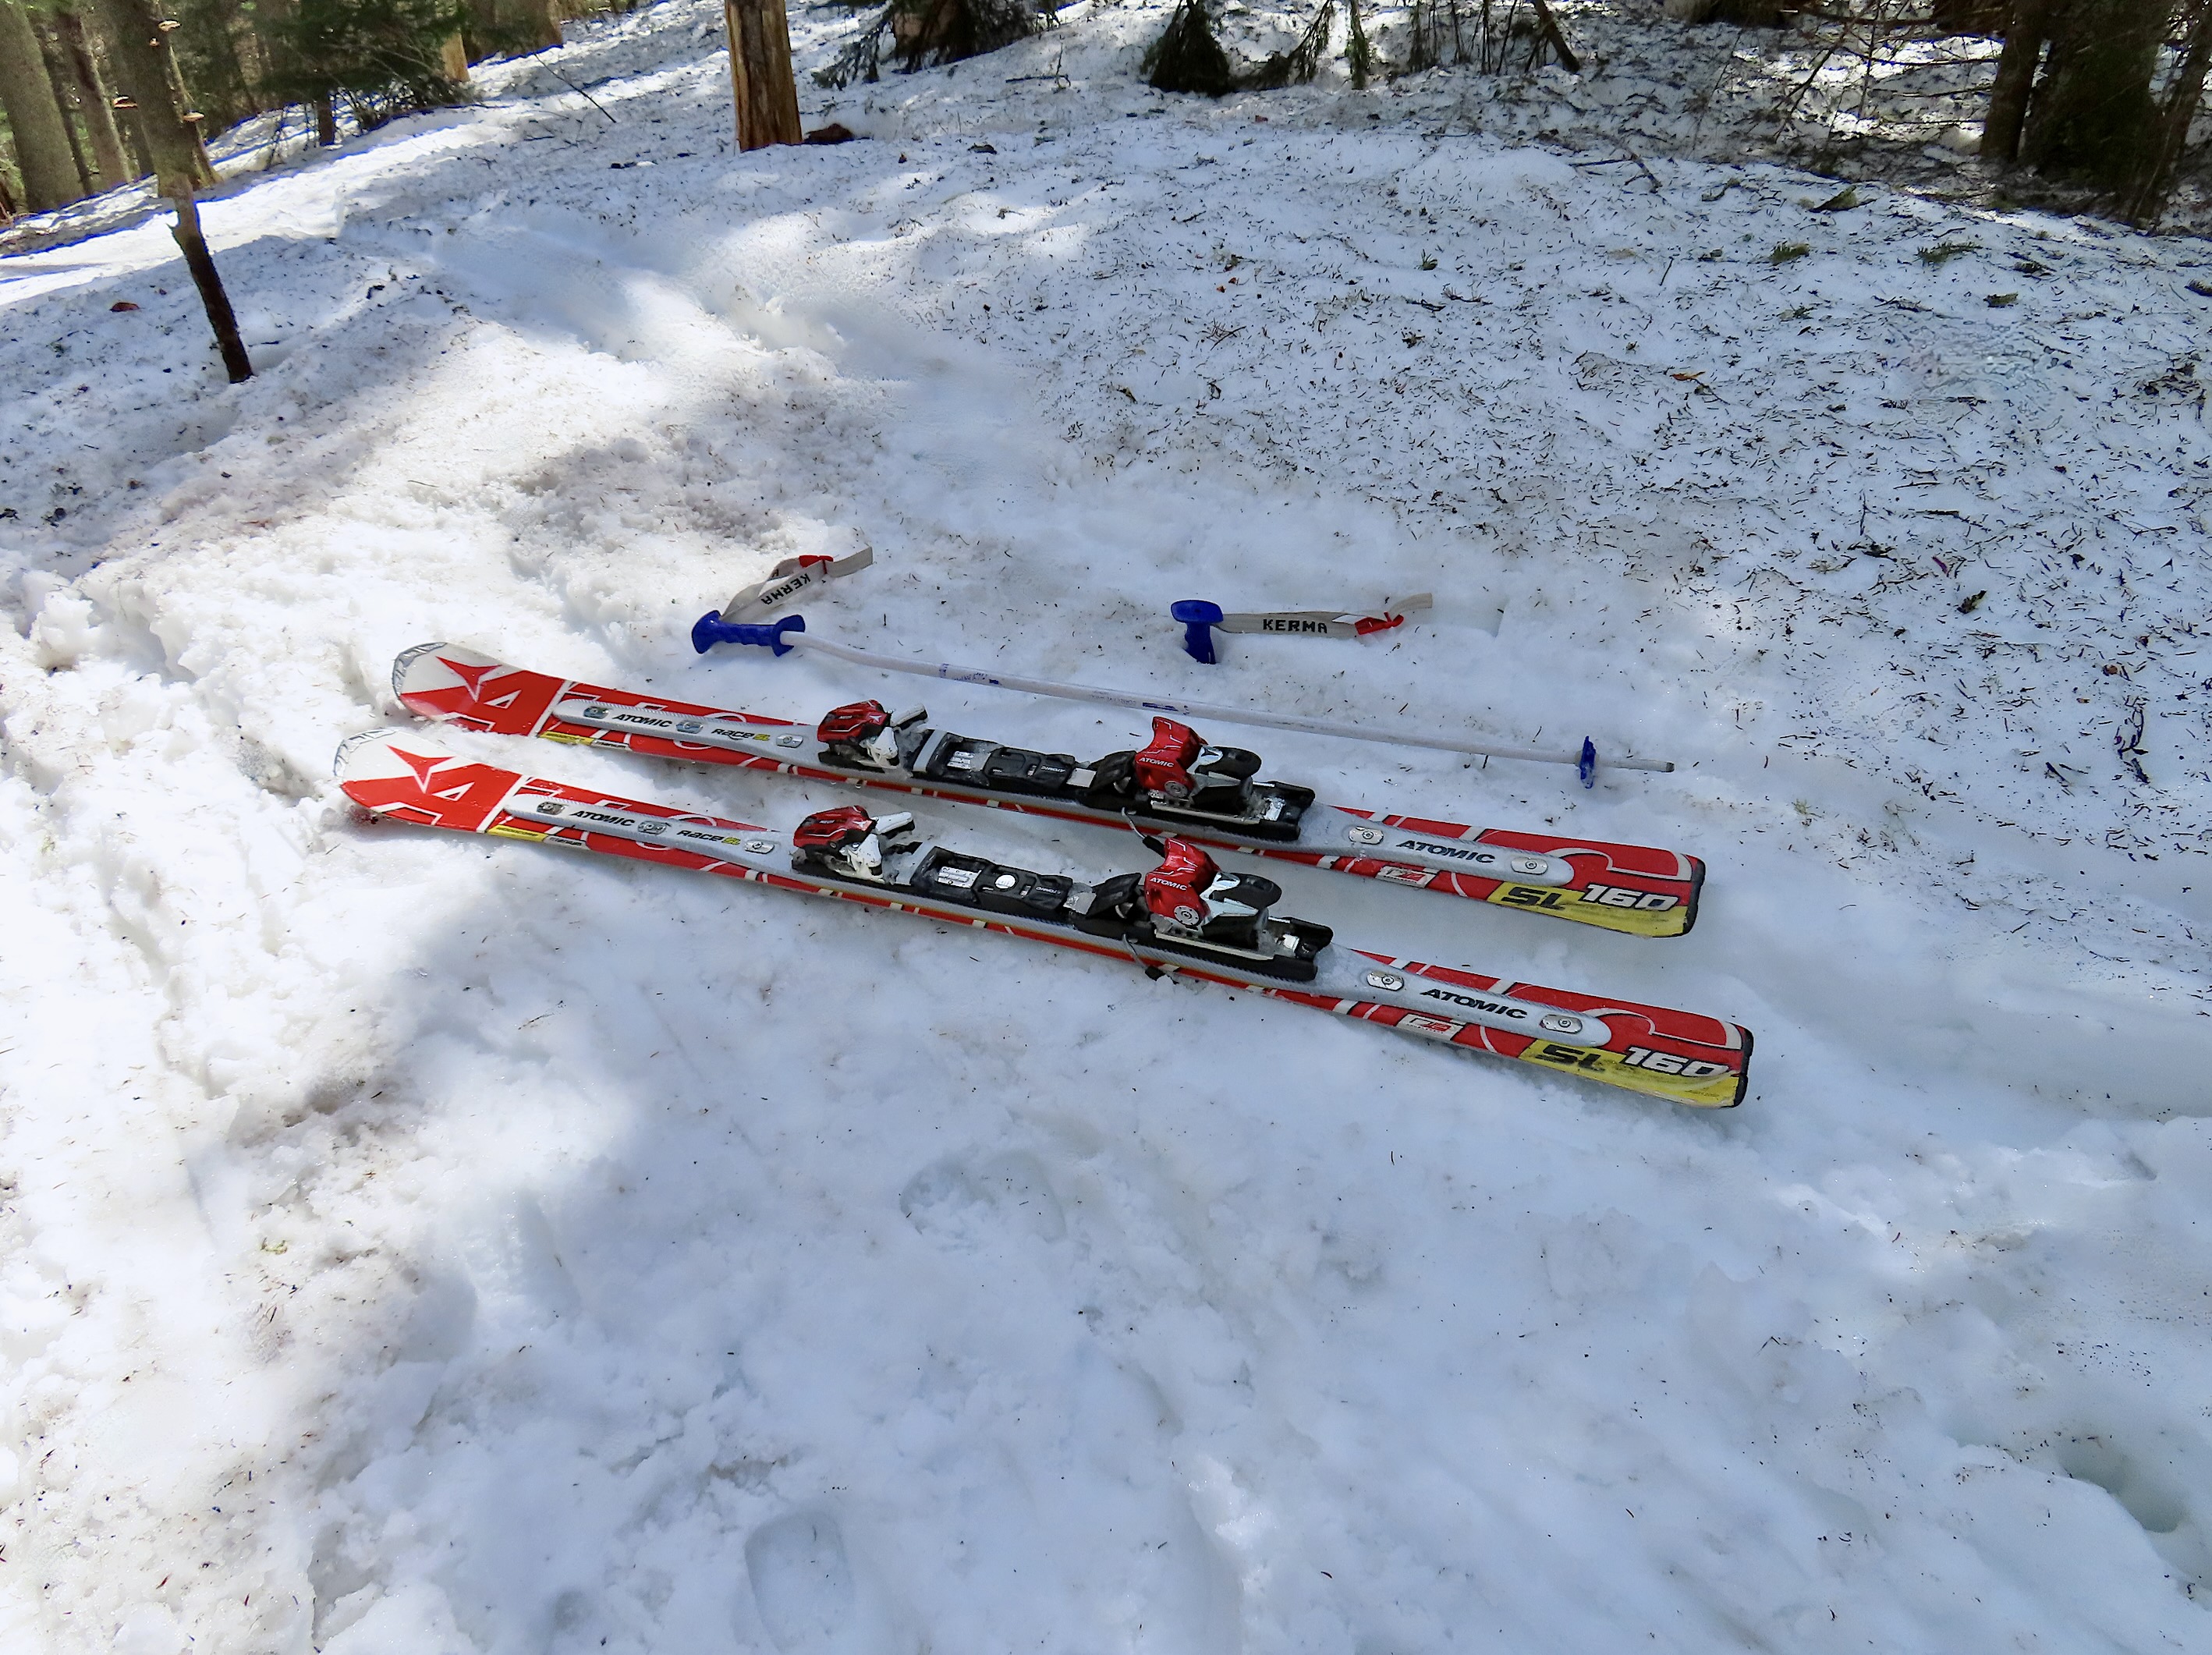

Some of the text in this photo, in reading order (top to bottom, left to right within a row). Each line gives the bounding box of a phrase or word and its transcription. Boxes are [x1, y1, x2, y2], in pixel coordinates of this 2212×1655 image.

[761, 573, 810, 604] KERMA
[1263, 618, 1328, 633] KERMA
[612, 714, 672, 728] ATOMIC
[1138, 757, 1175, 767] ATOMIC
[570, 810, 635, 827] ATOMIC
[1395, 840, 1496, 864] ATOMIC
[1150, 877, 1188, 891] ATOMIC
[1502, 884, 1680, 912] SL 160
[1420, 988, 1529, 1019] ATOMIC
[1534, 1044, 1732, 1078] SL 160
